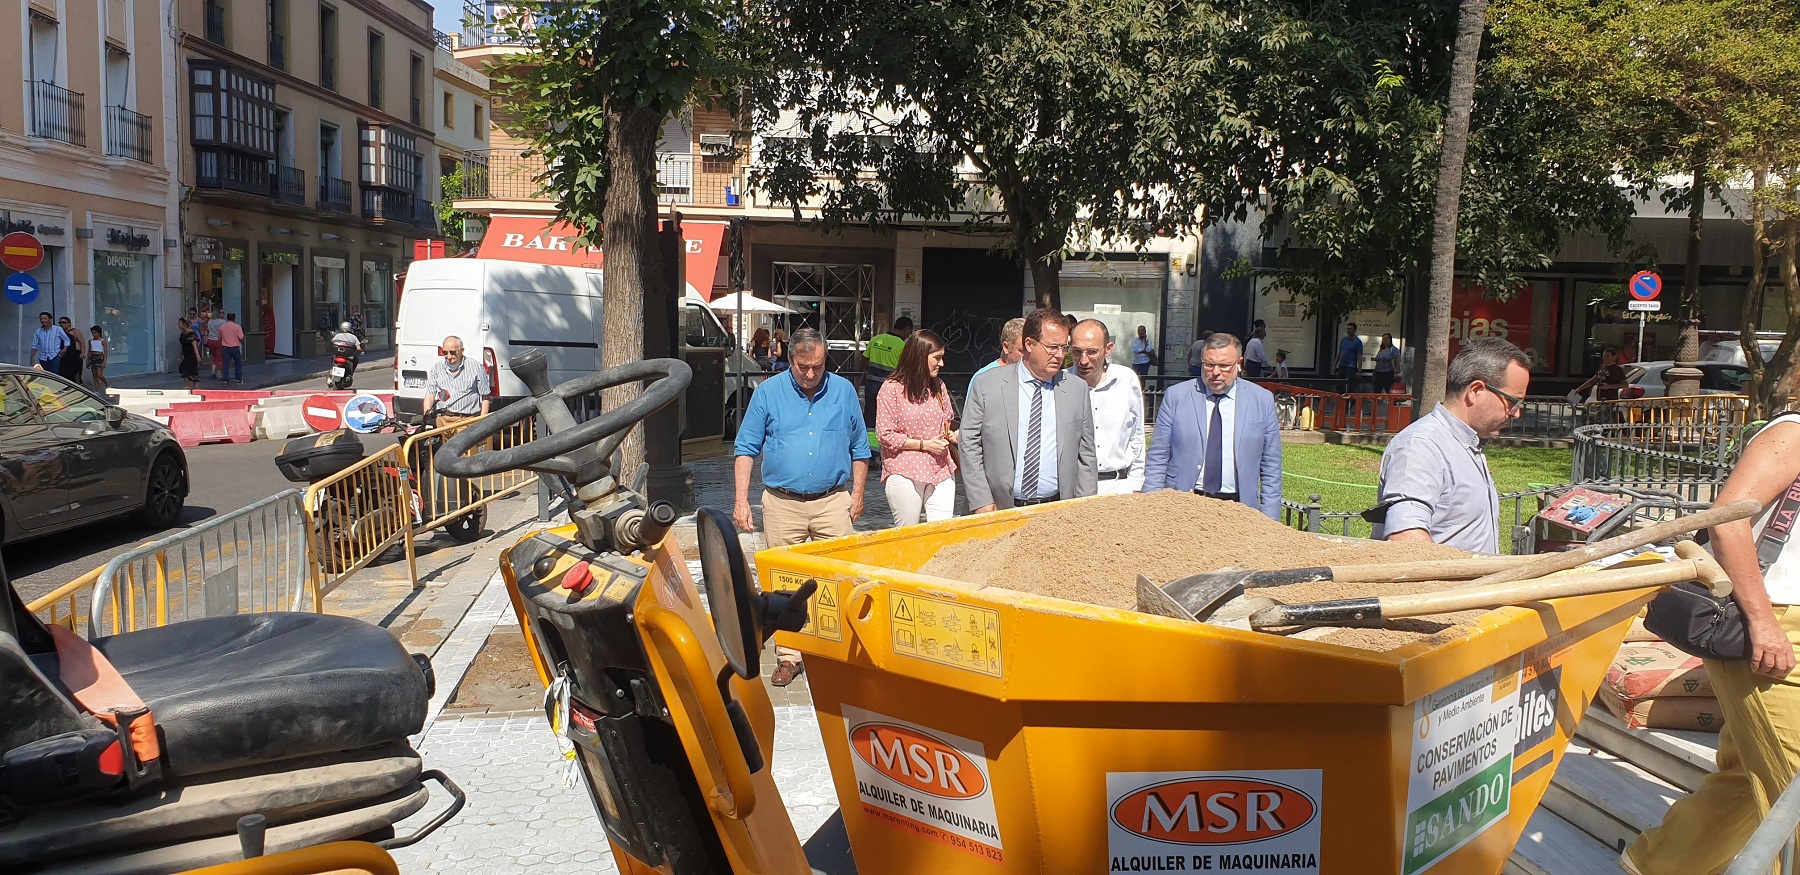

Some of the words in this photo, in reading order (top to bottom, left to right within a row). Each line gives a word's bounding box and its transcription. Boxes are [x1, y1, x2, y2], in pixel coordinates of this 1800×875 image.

[465, 226, 483, 234] ATM
[501, 233, 568, 251] BAR
[107, 255, 136, 268] DEPORTES
[778, 575, 794, 584] 1500
[1437, 713, 1443, 727] y
[1443, 704, 1460, 721] Medio
[1460, 692, 1485, 713] Ambiente
[1457, 688, 1465, 700] de
[1417, 711, 1499, 773] CONSERVACIÓN
[1500, 706, 1514, 728] DE
[869, 729, 968, 794] MSR
[1432, 739, 1497, 790] PAVIMENTOS
[859, 780, 908, 810] ALQUILER
[910, 797, 925, 815] DE
[928, 803, 999, 840] MAQUINARIA
[1141, 789, 1286, 833] MSR
[1424, 773, 1504, 849] SANDO
[863, 807, 938, 837] www.msrenting.com
[950, 835, 967, 849] 954
[968, 841, 984, 855] 513
[986, 847, 1003, 861] 823
[1110, 855, 1185, 872] ALQUILER
[1193, 855, 1212, 870] DE
[1220, 853, 1317, 870] MAQUINARIA
